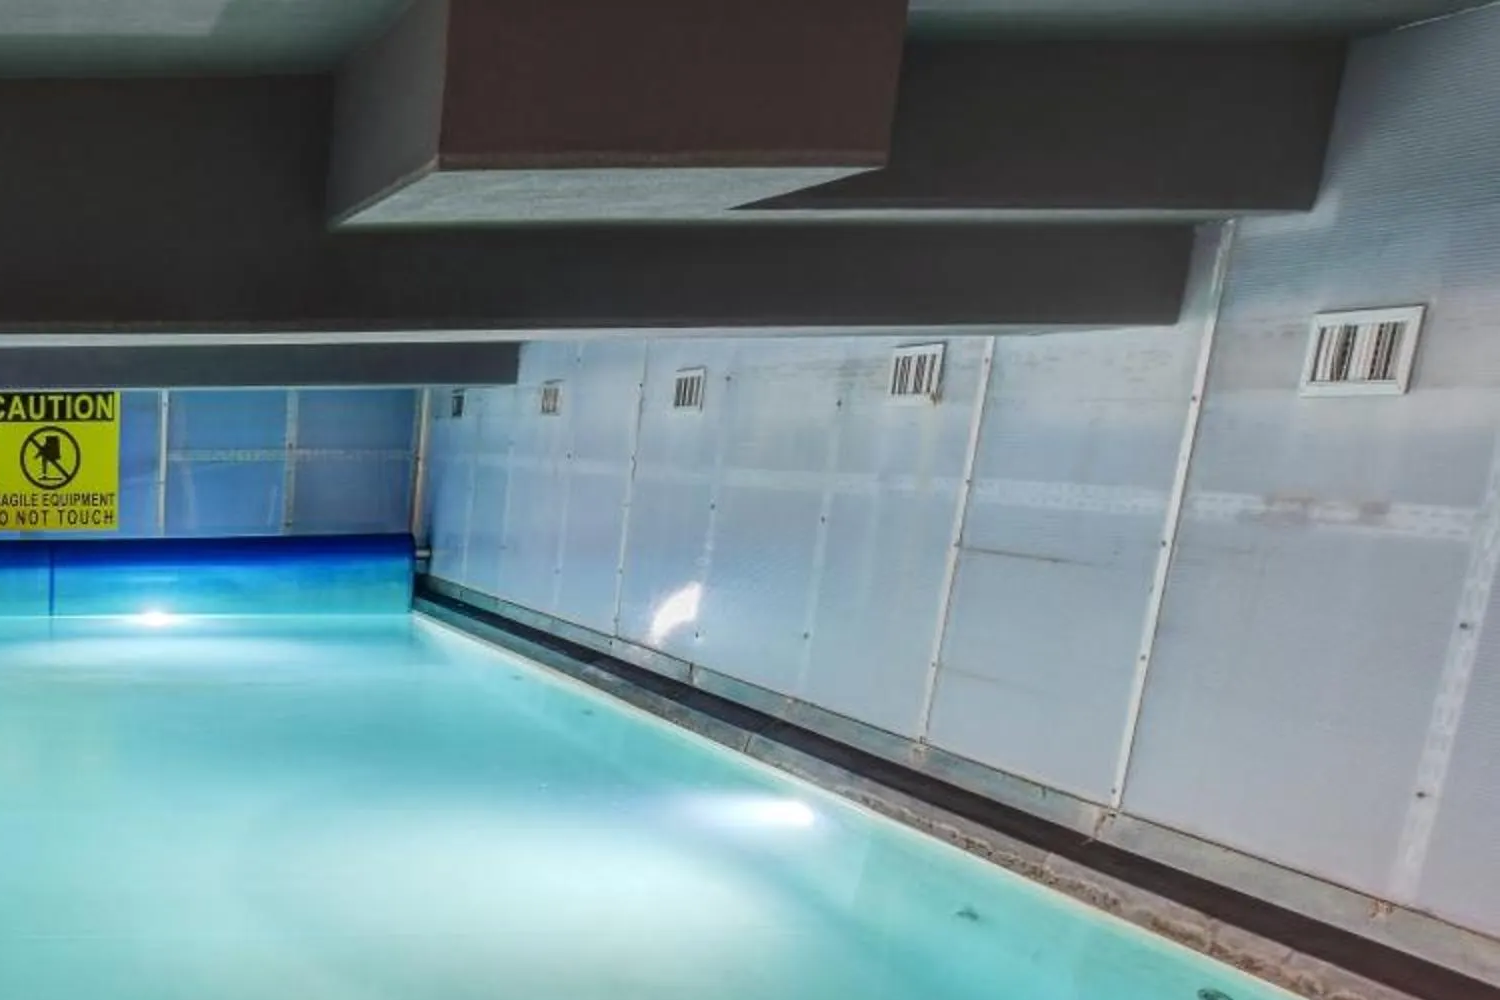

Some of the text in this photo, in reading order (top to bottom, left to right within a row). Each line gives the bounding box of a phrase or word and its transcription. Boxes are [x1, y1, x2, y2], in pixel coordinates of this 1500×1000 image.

[43, 493, 116, 506] EQUIPMENT
[16, 510, 49, 525] NOT
[57, 510, 114, 525] TOUCH
